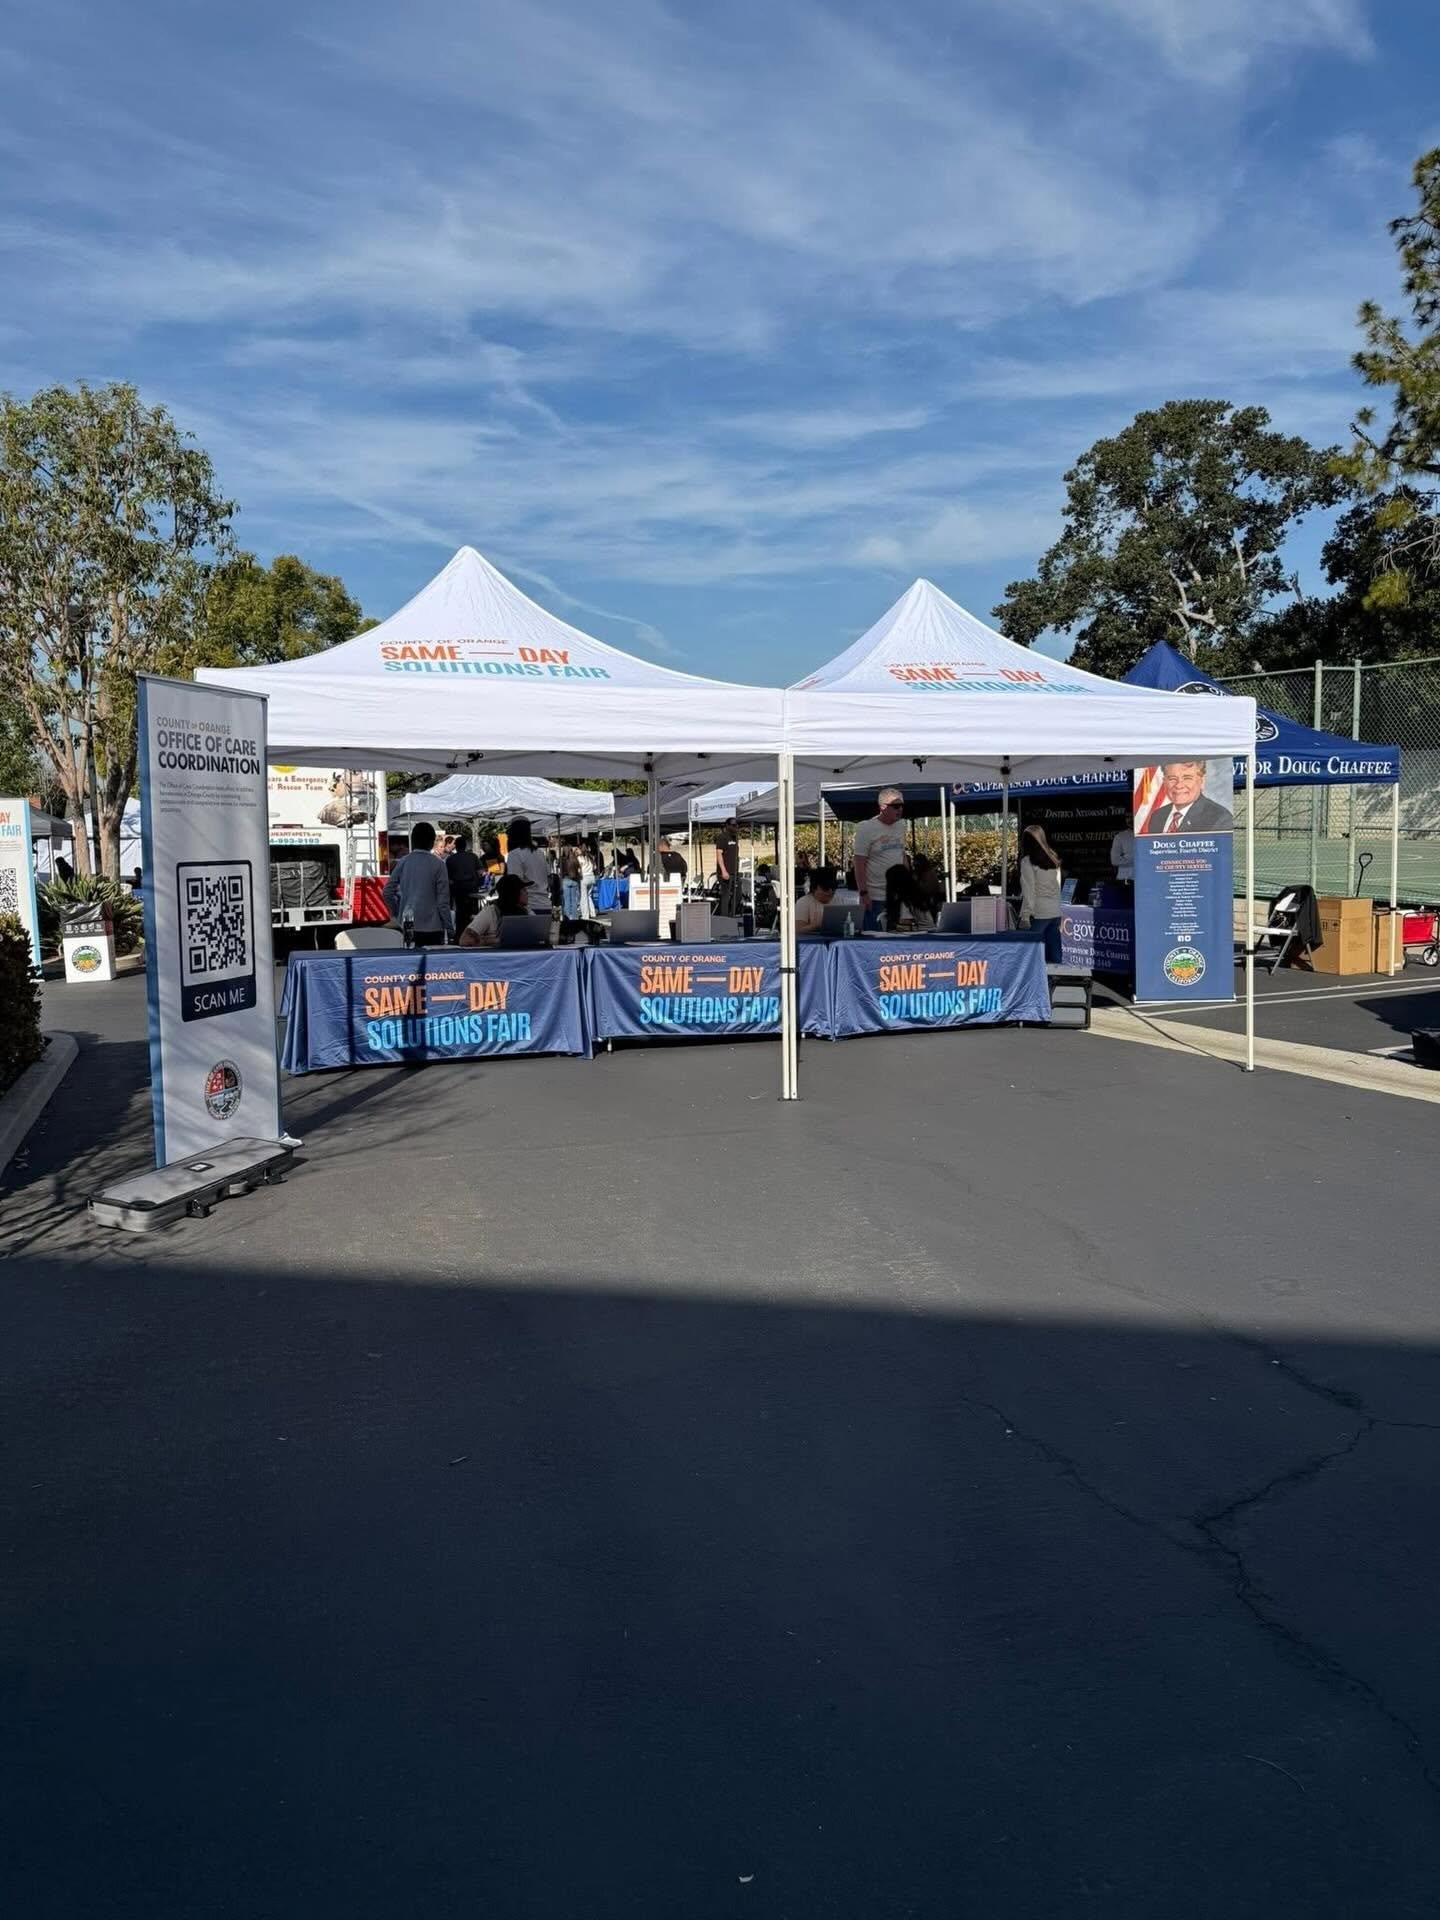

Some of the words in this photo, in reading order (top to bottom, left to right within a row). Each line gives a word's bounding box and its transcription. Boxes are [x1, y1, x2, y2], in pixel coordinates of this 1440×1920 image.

[380, 638, 433, 646] COUNTY
[381, 645, 464, 661] SAME
[518, 647, 569, 664] DAY
[384, 661, 543, 676] SOLUTIONS
[549, 664, 611, 679] FAIR
[889, 668, 963, 681] SAME
[998, 669, 1047, 683] DAY
[157, 716, 191, 730] COUNTY
[198, 722, 232, 735] ORANGE
[157, 730, 201, 751] OFFICE
[205, 735, 222, 752] OF
[225, 738, 256, 756] CARE
[158, 751, 260, 775] COORDINATION
[1279, 756, 1320, 775] DOUG
[1327, 756, 1392, 775] CHAFFEE
[291, 775, 328, 784] Emergency
[973, 781, 1032, 793] SUPERISOR
[1072, 770, 1128, 784] CHAFFEE
[0, 811, 10, 823] AY
[2, 825, 21, 837] FAIR
[1153, 840, 1176, 849] DOUG
[1179, 840, 1215, 848] CHAFFEE
[1060, 917, 1130, 941] Cgov.com
[642, 955, 676, 963] COUNTY
[679, 955, 691, 963] OF
[692, 955, 727, 963] ORANGE
[880, 954, 911, 962] COUNTY
[924, 952, 955, 960] ORANGE
[364, 974, 406, 984] COUNTY
[408, 973, 421, 981] OF
[425, 971, 465, 981] ORANGE
[641, 965, 694, 993] SAME
[729, 966, 764, 993] DAY
[880, 964, 926, 991] SAME
[957, 960, 988, 986] DAY
[194, 992, 226, 1012] SCAN
[229, 988, 245, 1005] ME
[365, 985, 428, 1018] SAME
[469, 981, 509, 1011] DAY
[879, 990, 965, 1021] SOLUTIONS
[969, 988, 1003, 1013] FAIR
[640, 997, 738, 1024] SOLUTIONS
[741, 997, 779, 1024] FAIR
[367, 1014, 483, 1050] SOLUTIONS
[487, 1013, 532, 1041] FAIR
